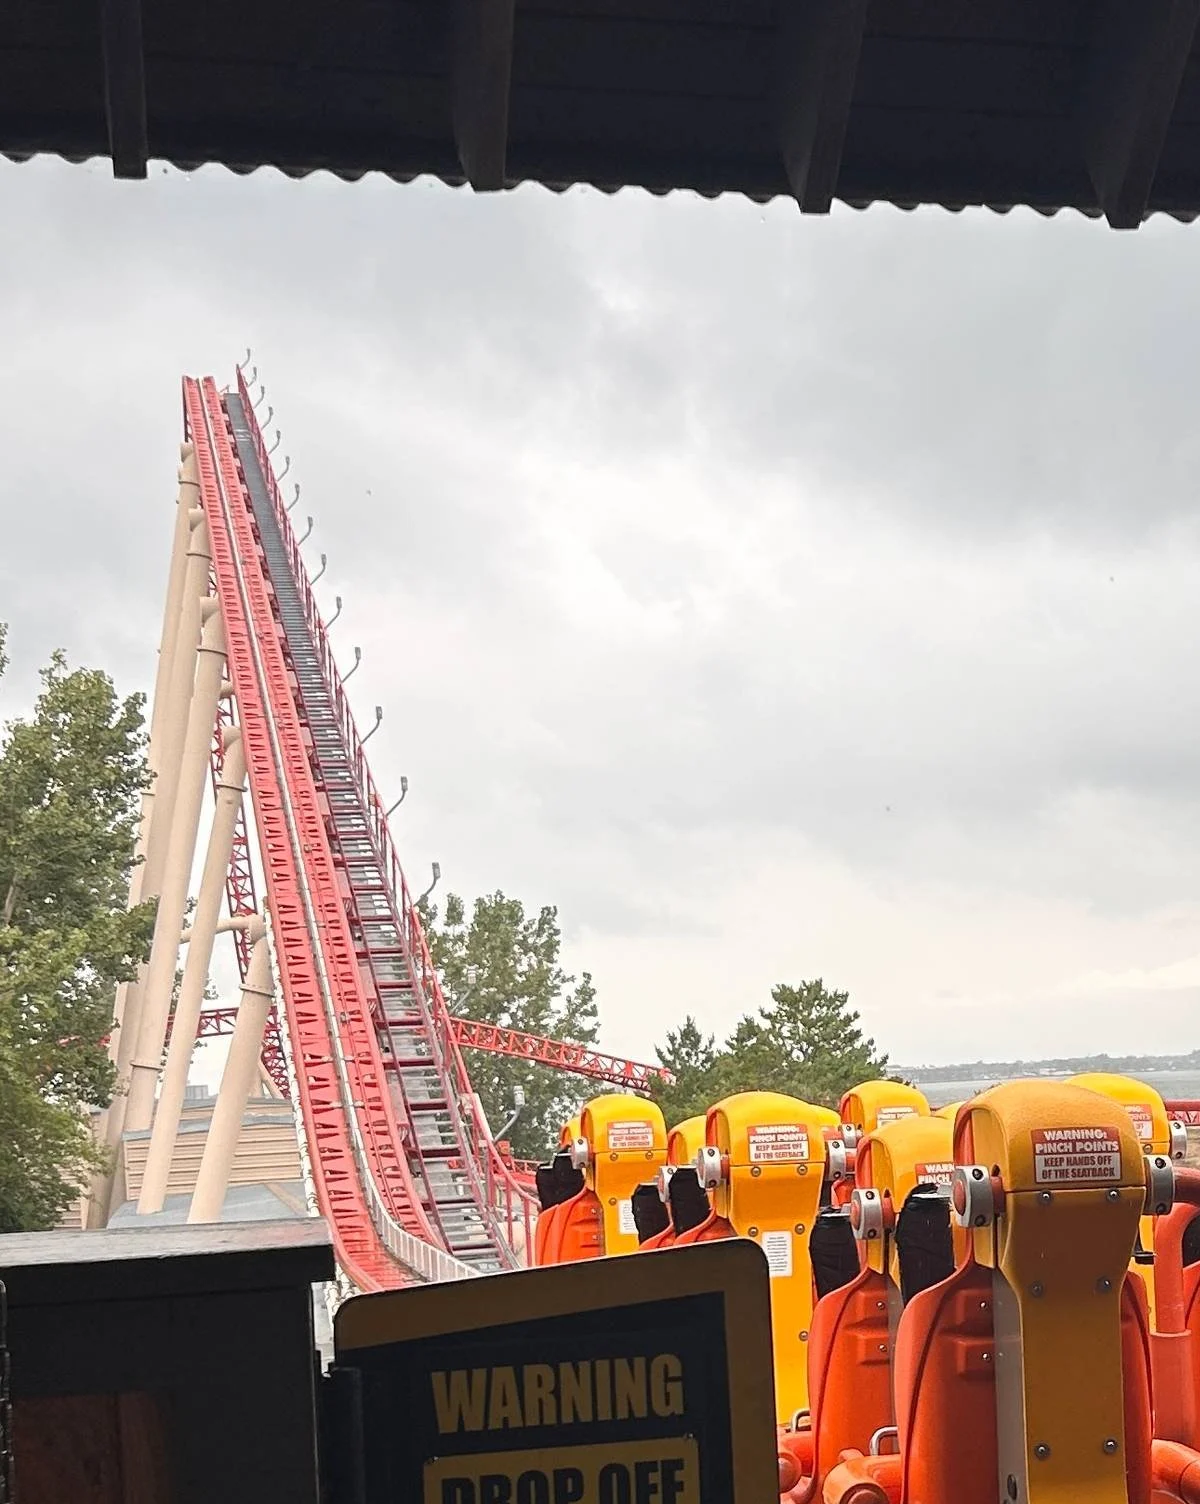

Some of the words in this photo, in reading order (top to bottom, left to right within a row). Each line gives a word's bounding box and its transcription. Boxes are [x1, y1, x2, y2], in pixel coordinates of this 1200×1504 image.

[1043, 1129, 1107, 1141] WARNING:
[1035, 1142, 1072, 1154] PINCH
[1076, 1141, 1119, 1152] POINTS
[1044, 1157, 1065, 1168] KEEP
[1066, 1156, 1096, 1167] HANDS
[1097, 1155, 1112, 1165] OFF
[1042, 1169, 1054, 1179] OF
[1054, 1168, 1071, 1179] THE
[1071, 1167, 1115, 1178] SEATBACK
[431, 1354, 684, 1434] WARNING
